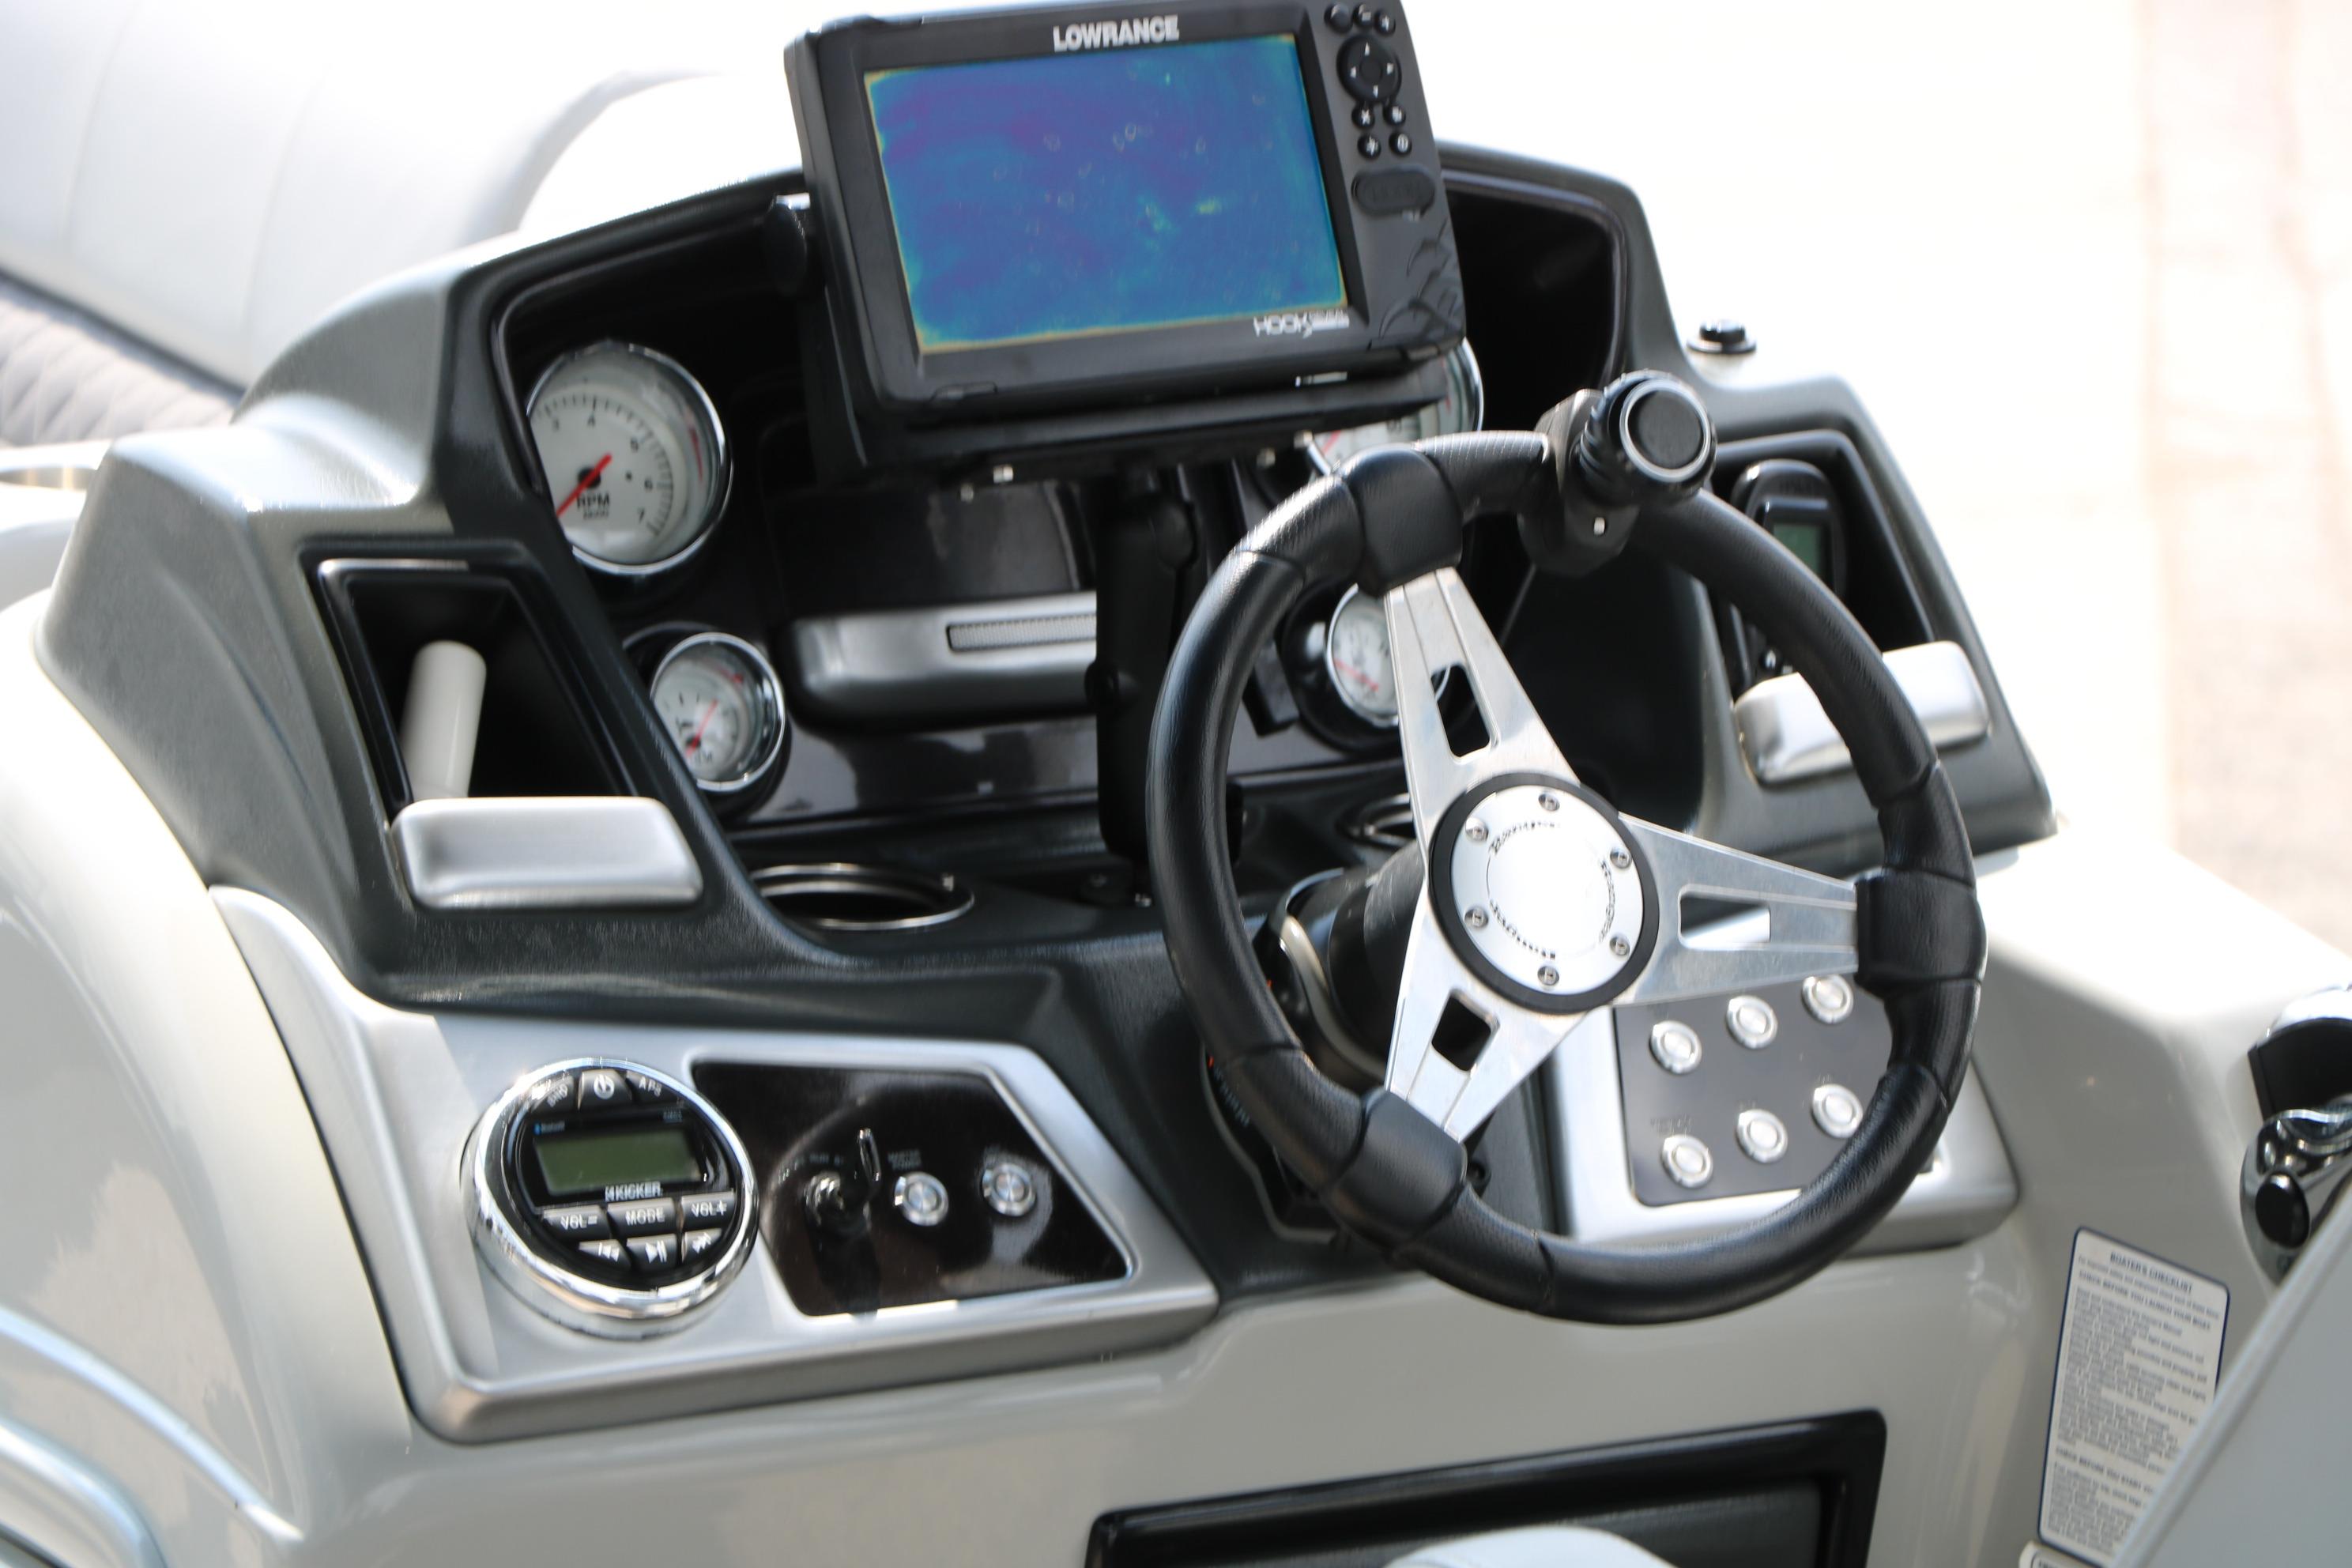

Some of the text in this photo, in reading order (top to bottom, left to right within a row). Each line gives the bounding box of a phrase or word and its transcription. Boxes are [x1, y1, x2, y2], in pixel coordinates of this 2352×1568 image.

[1053, 13, 1180, 53] LOWRANCE
[614, 1181, 662, 1201] KICKER
[624, 1206, 666, 1227] MODE
